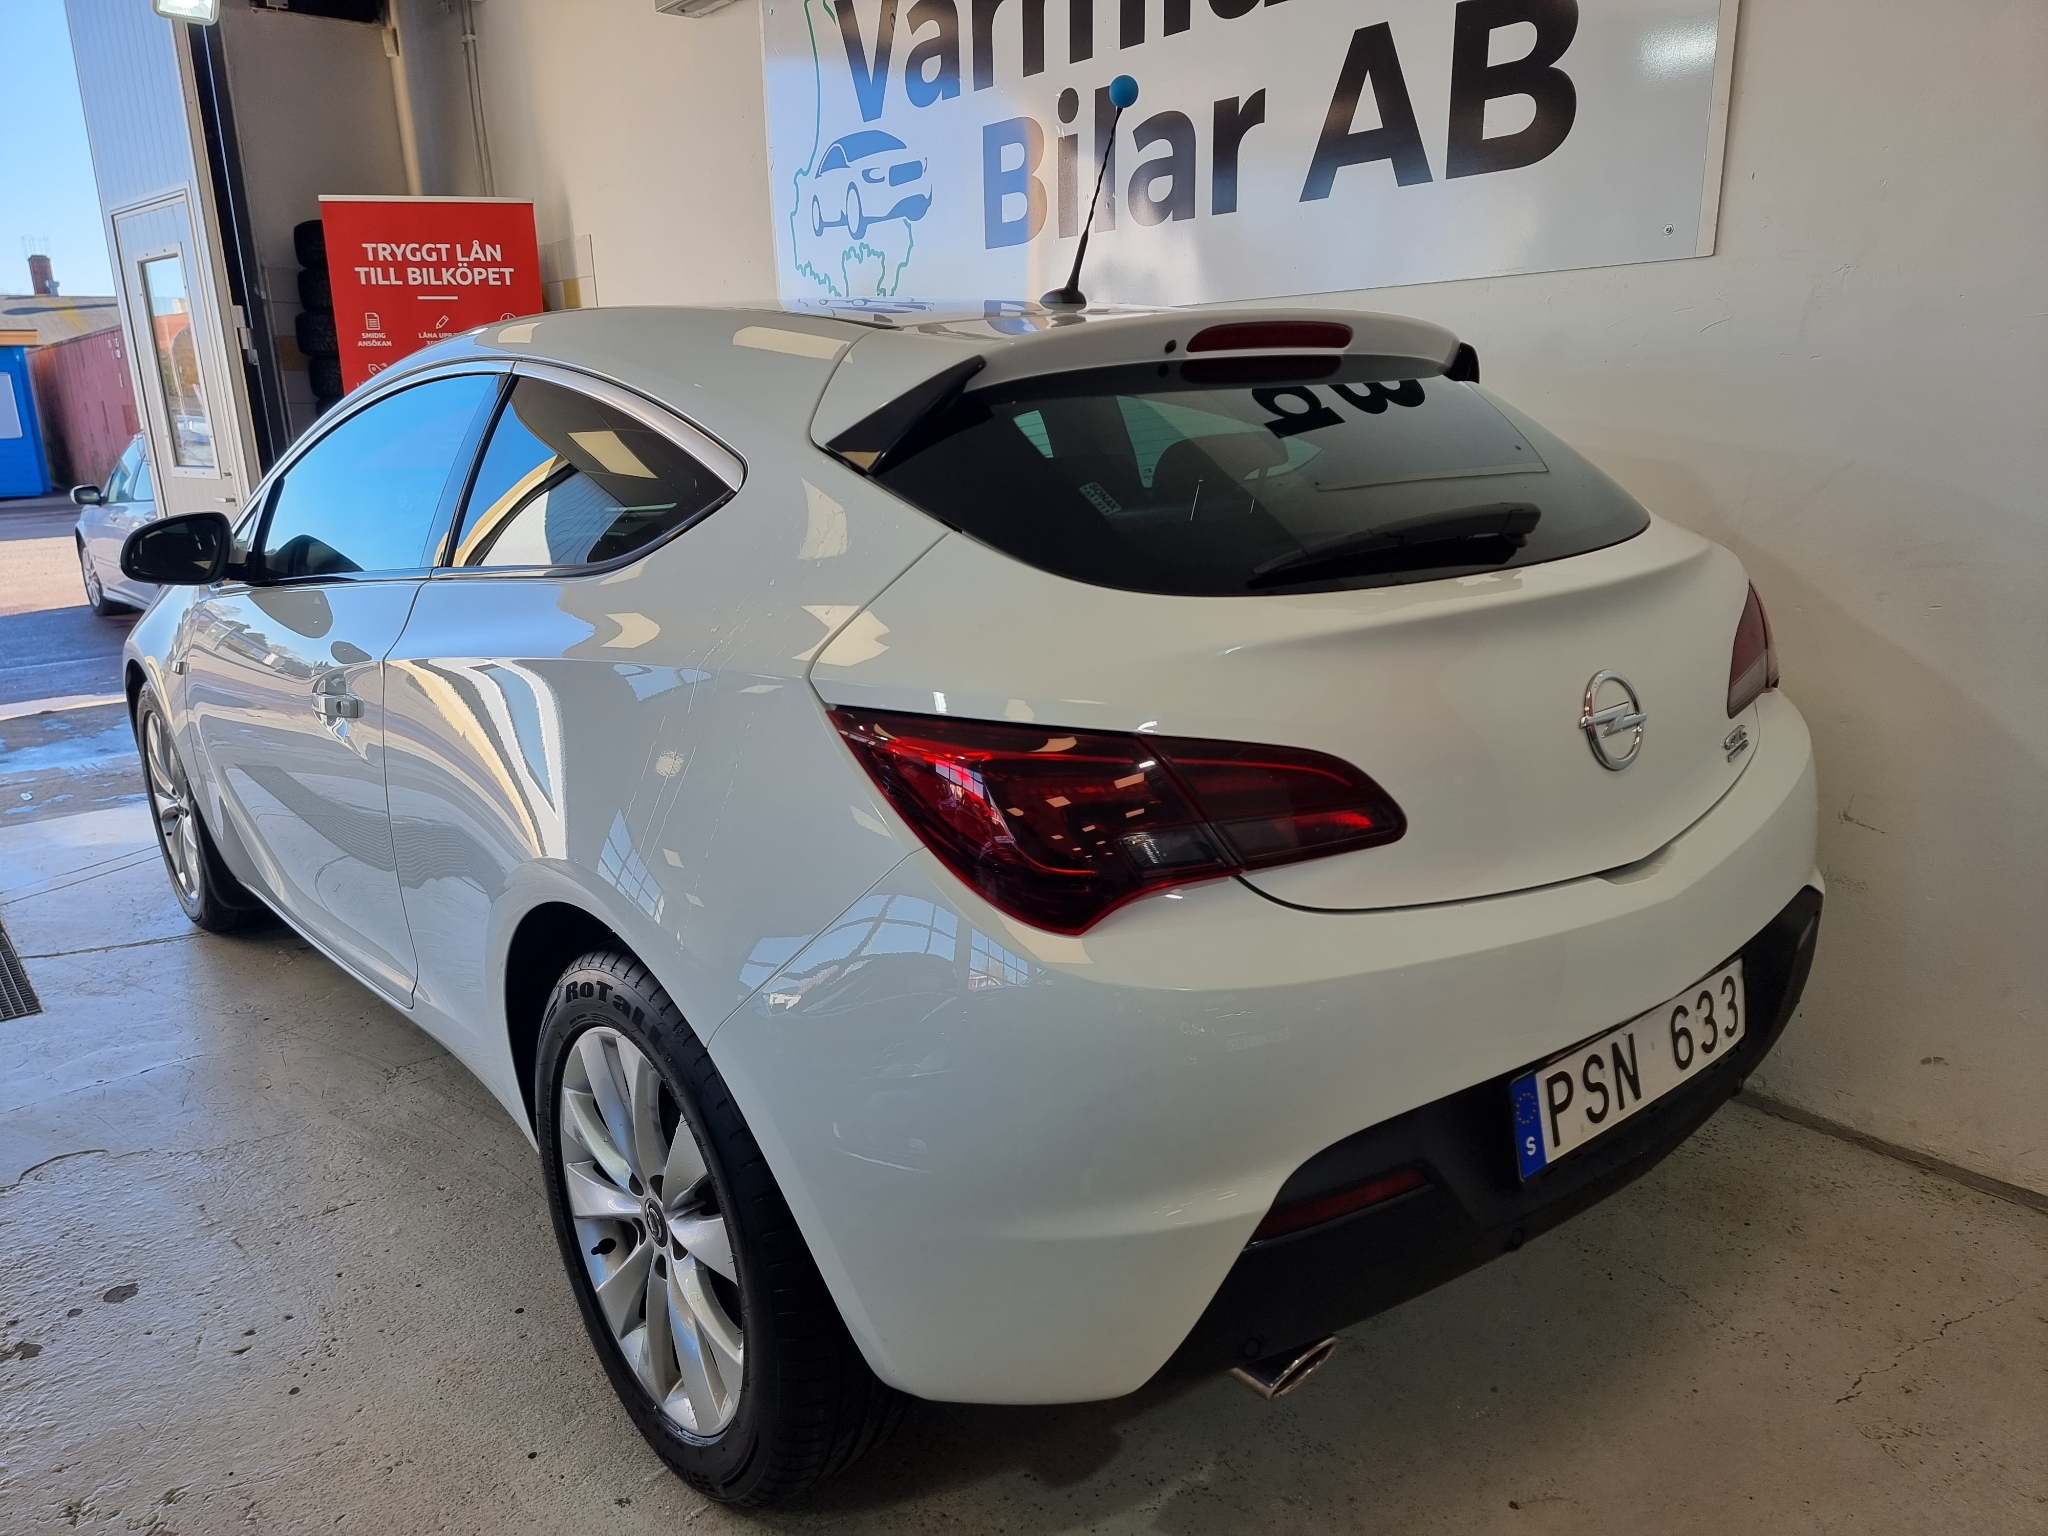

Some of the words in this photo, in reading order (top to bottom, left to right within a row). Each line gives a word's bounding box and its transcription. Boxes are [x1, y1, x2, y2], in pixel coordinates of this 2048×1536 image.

[982, 86, 1266, 250] Bilar
[1299, 0, 1579, 202] AB
[361, 243, 450, 262] TRYGGT
[456, 239, 502, 262] LÅN
[354, 267, 403, 285] TILL
[407, 263, 514, 286] BILKÖPET
[357, 339, 393, 347] ANSÖKAN
[418, 331, 438, 339] LÅNA
[1546, 1032, 1642, 1149] PSN
[1670, 975, 1740, 1070] 633
[1525, 1136, 1537, 1156] S
